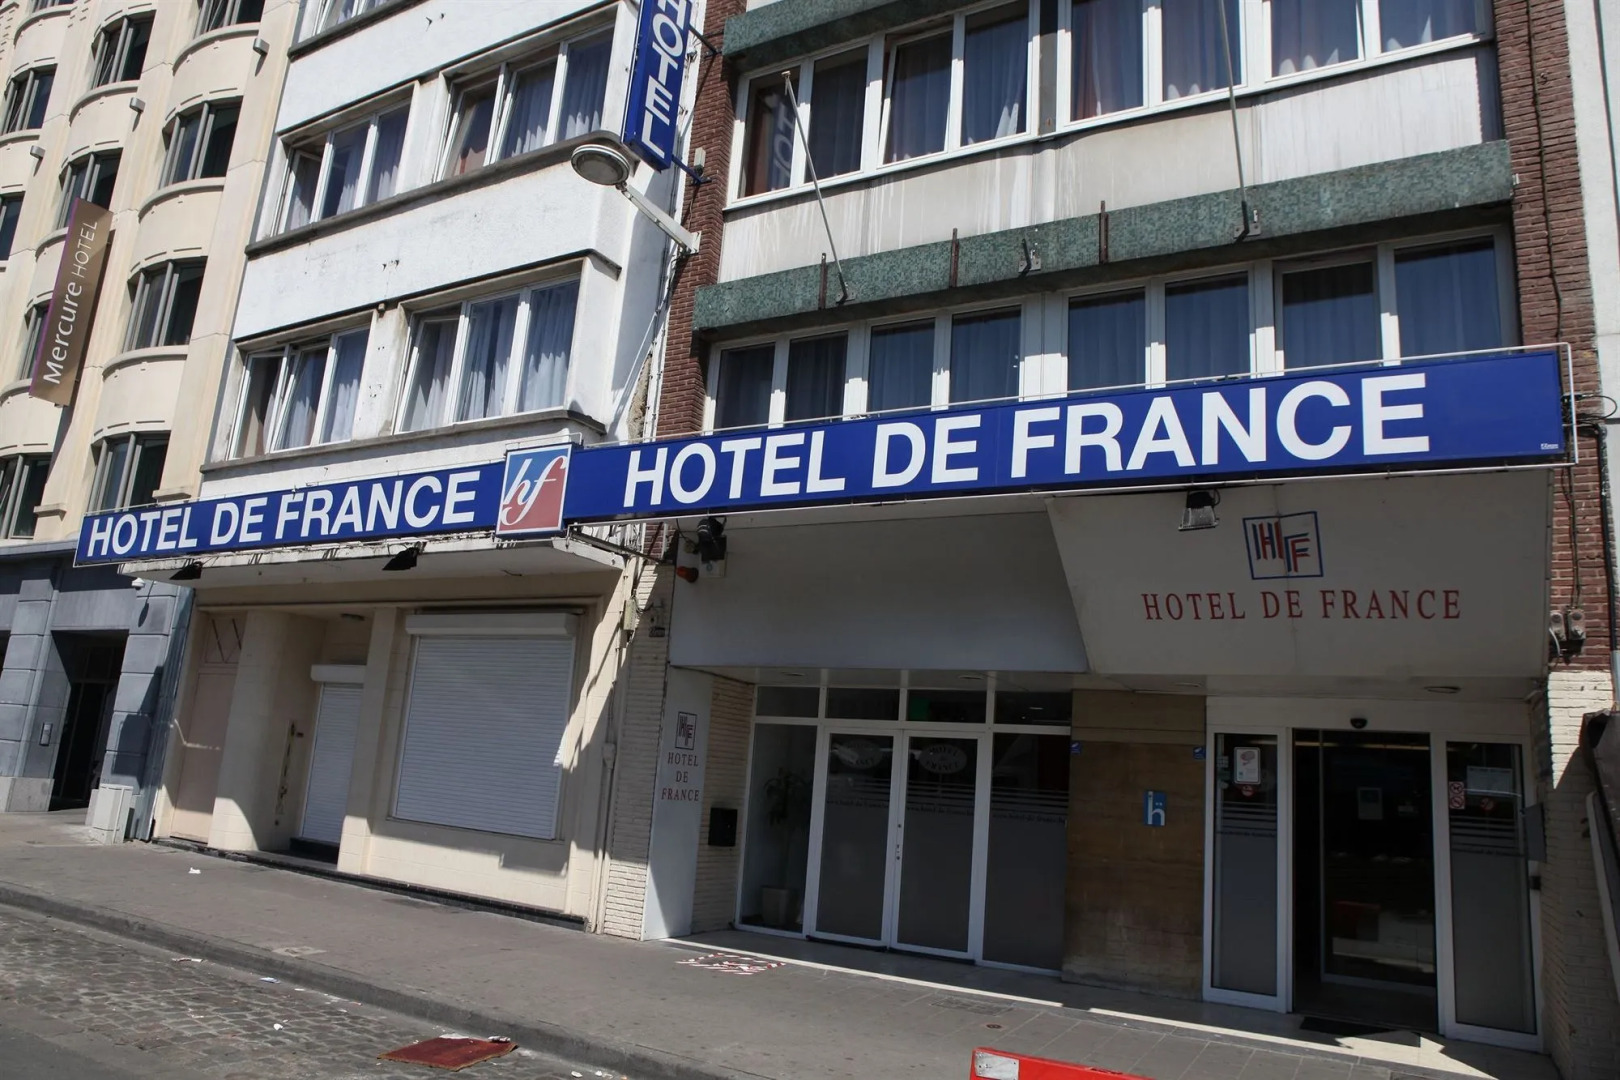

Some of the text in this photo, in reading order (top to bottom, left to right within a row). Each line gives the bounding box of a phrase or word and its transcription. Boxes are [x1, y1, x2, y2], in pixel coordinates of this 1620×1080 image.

[42, 221, 98, 385] Mercure HOTEL
[623, 372, 1430, 508] HOTEL DE FRANCE
[87, 470, 481, 558] HOTEL DE FRANCE
[1141, 589, 1462, 621] HOTEL DE FRANCE
[667, 752, 699, 767] HOTEL
[675, 770, 689, 783] DE
[661, 787, 700, 802] FRANCE
